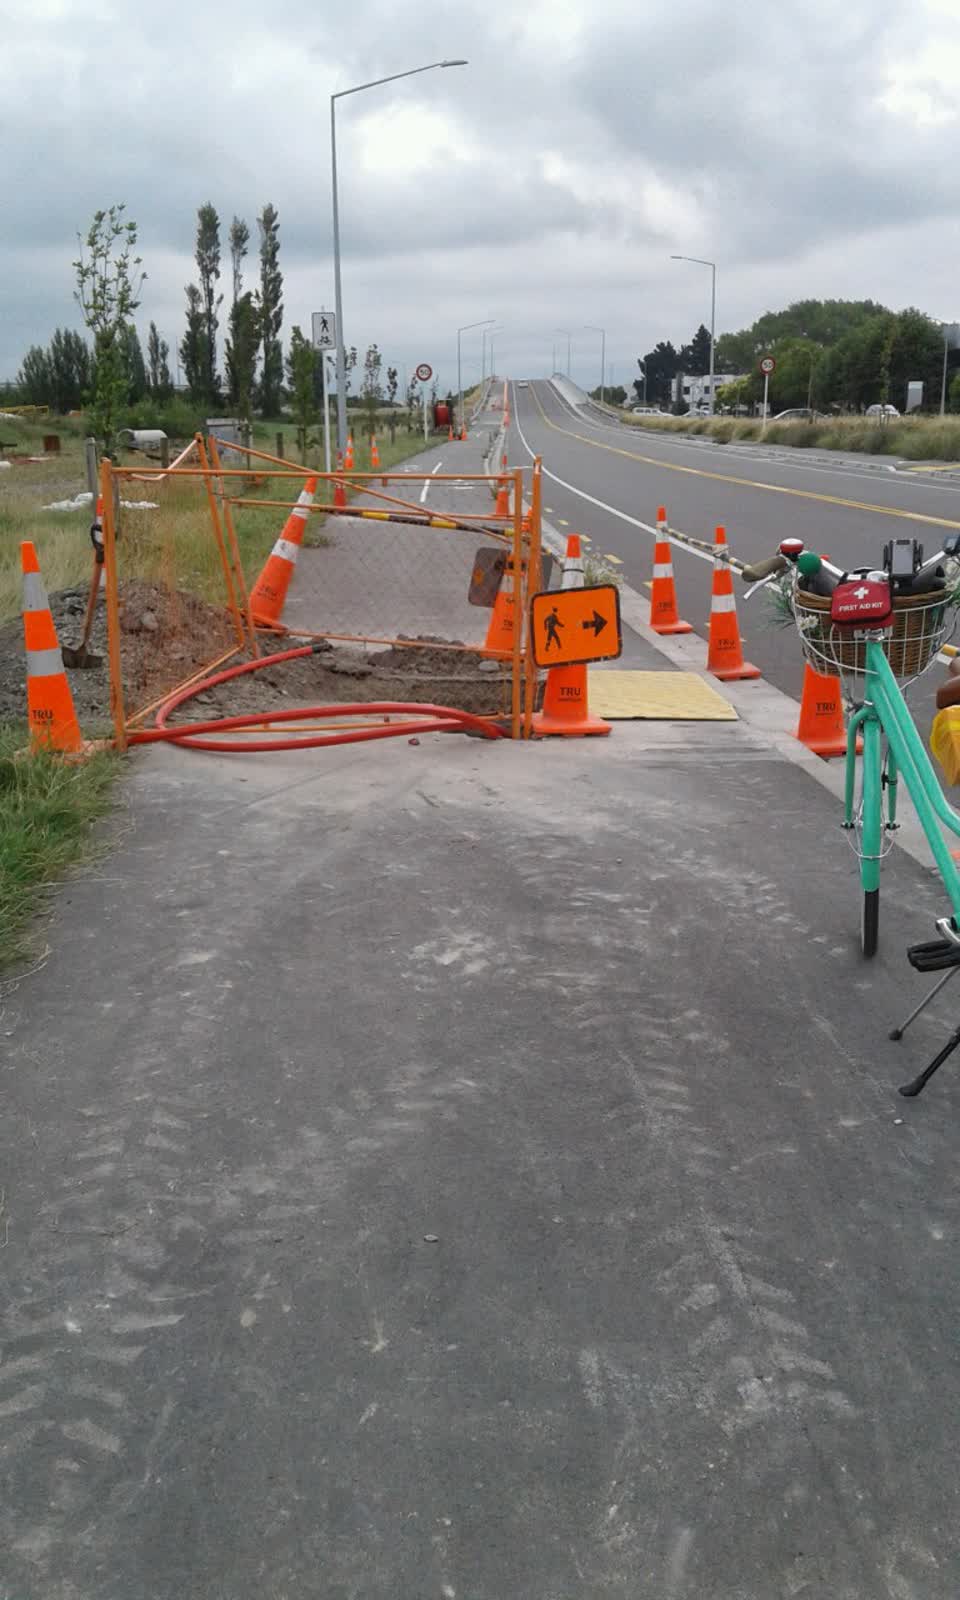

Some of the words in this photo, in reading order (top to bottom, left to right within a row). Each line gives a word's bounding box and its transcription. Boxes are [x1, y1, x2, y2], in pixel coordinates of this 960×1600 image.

[764, 361, 773, 369] 50
[419, 368, 430, 376] 50
[839, 604, 858, 612] FIRST
[718, 638, 736, 648] TRU
[559, 686, 581, 697] TRU
[815, 701, 836, 712] TRU
[32, 709, 53, 720] TRU
